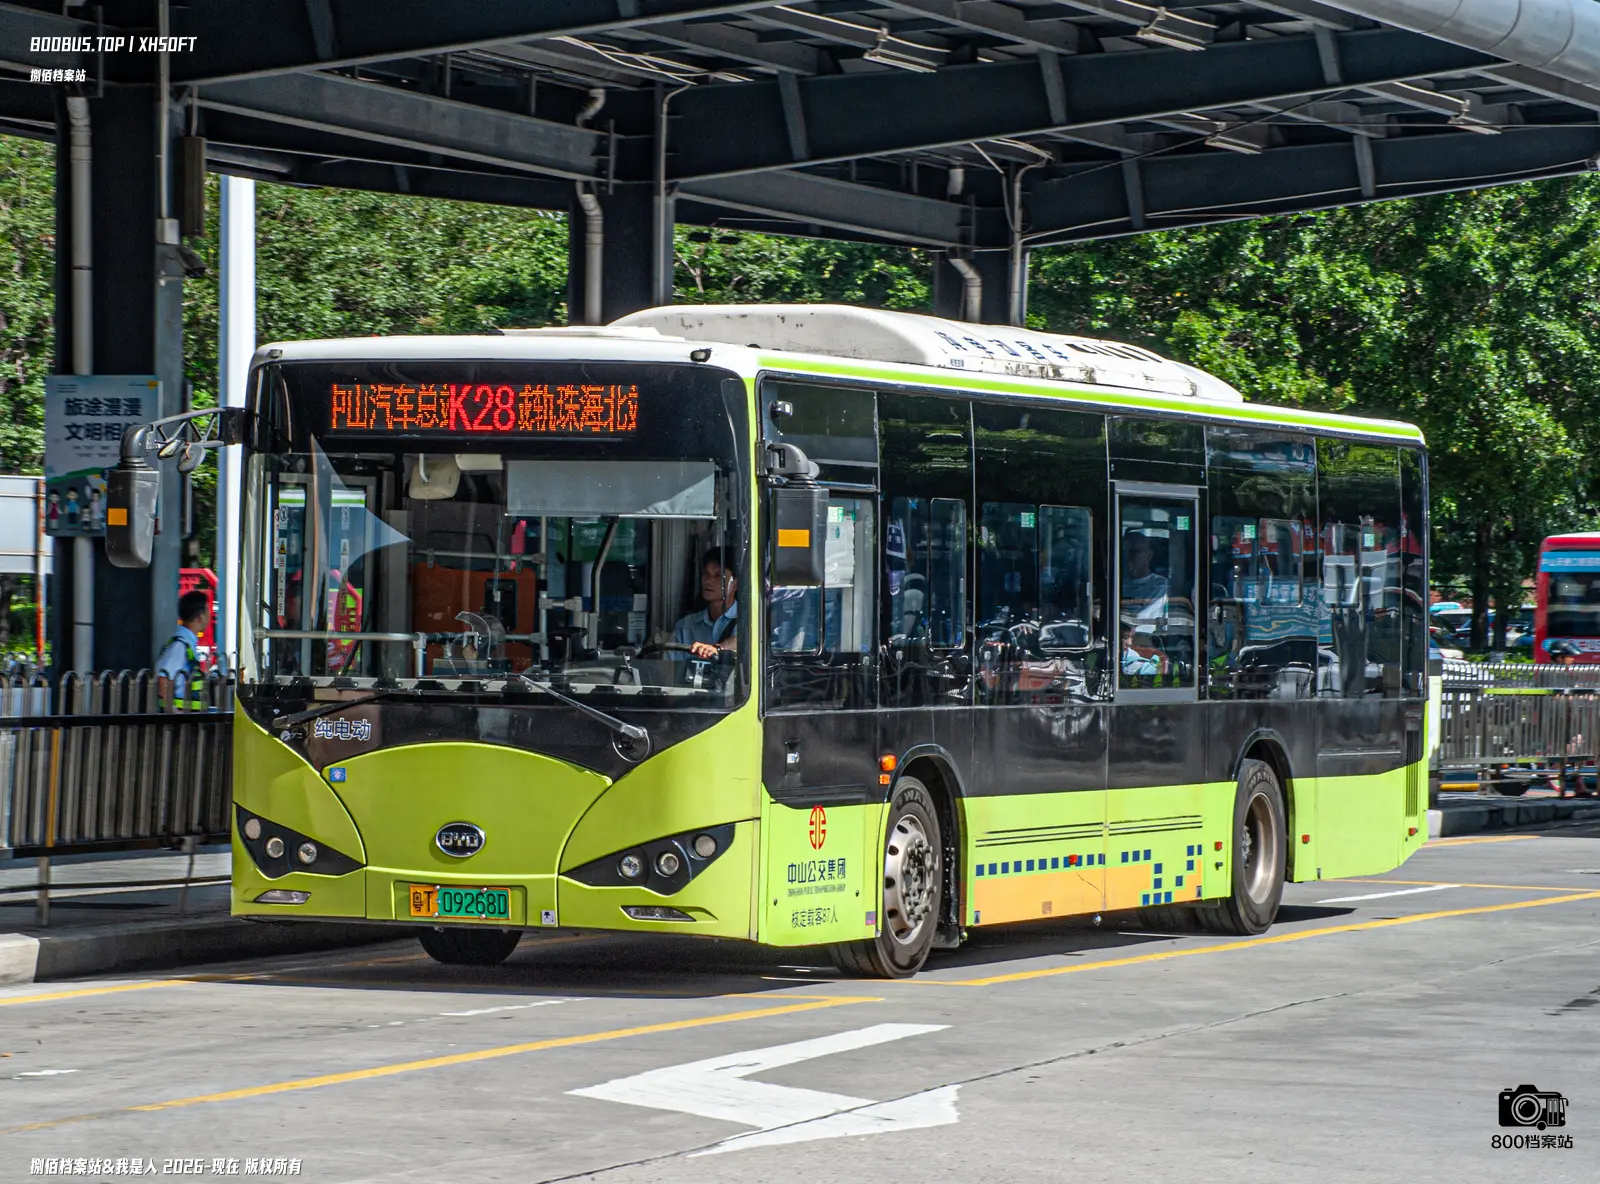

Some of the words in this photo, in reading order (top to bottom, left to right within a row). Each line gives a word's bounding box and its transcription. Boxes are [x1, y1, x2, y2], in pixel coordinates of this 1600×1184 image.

[64, 397, 142, 417] 旅途漫漫
[450, 384, 516, 431] K28
[64, 422, 141, 442] 文明相
[314, 717, 372, 741] 纯电动
[441, 832, 479, 847] BYD
[787, 858, 846, 884] 中山公交集团
[791, 904, 839, 929] 核定载客87人
